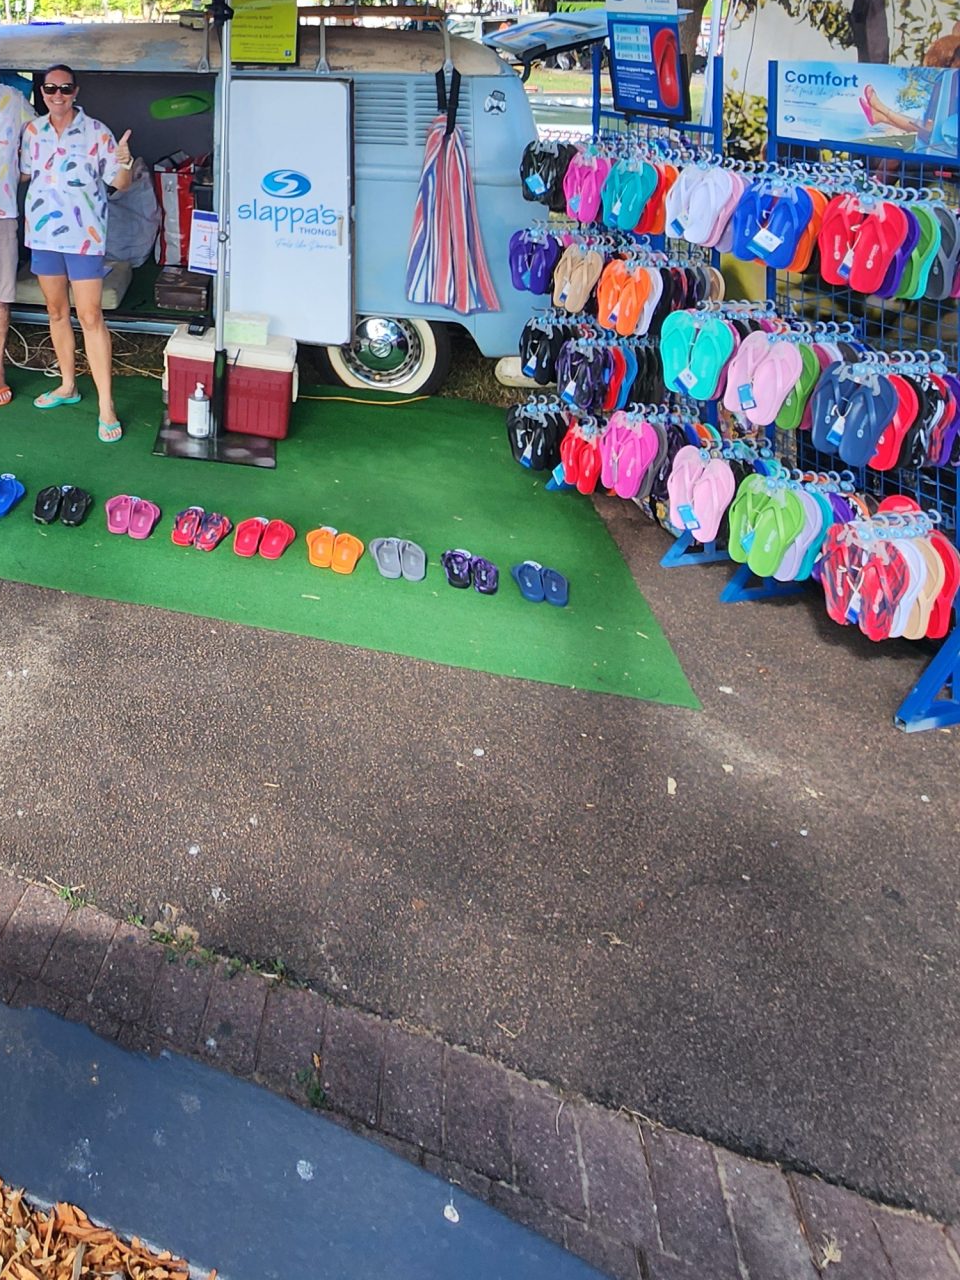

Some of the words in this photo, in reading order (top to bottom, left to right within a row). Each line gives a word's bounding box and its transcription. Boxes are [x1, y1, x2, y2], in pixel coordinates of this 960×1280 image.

[784, 70, 858, 88] Comfort
[238, 198, 337, 233] slappa's
[300, 227, 337, 237] THONGS
